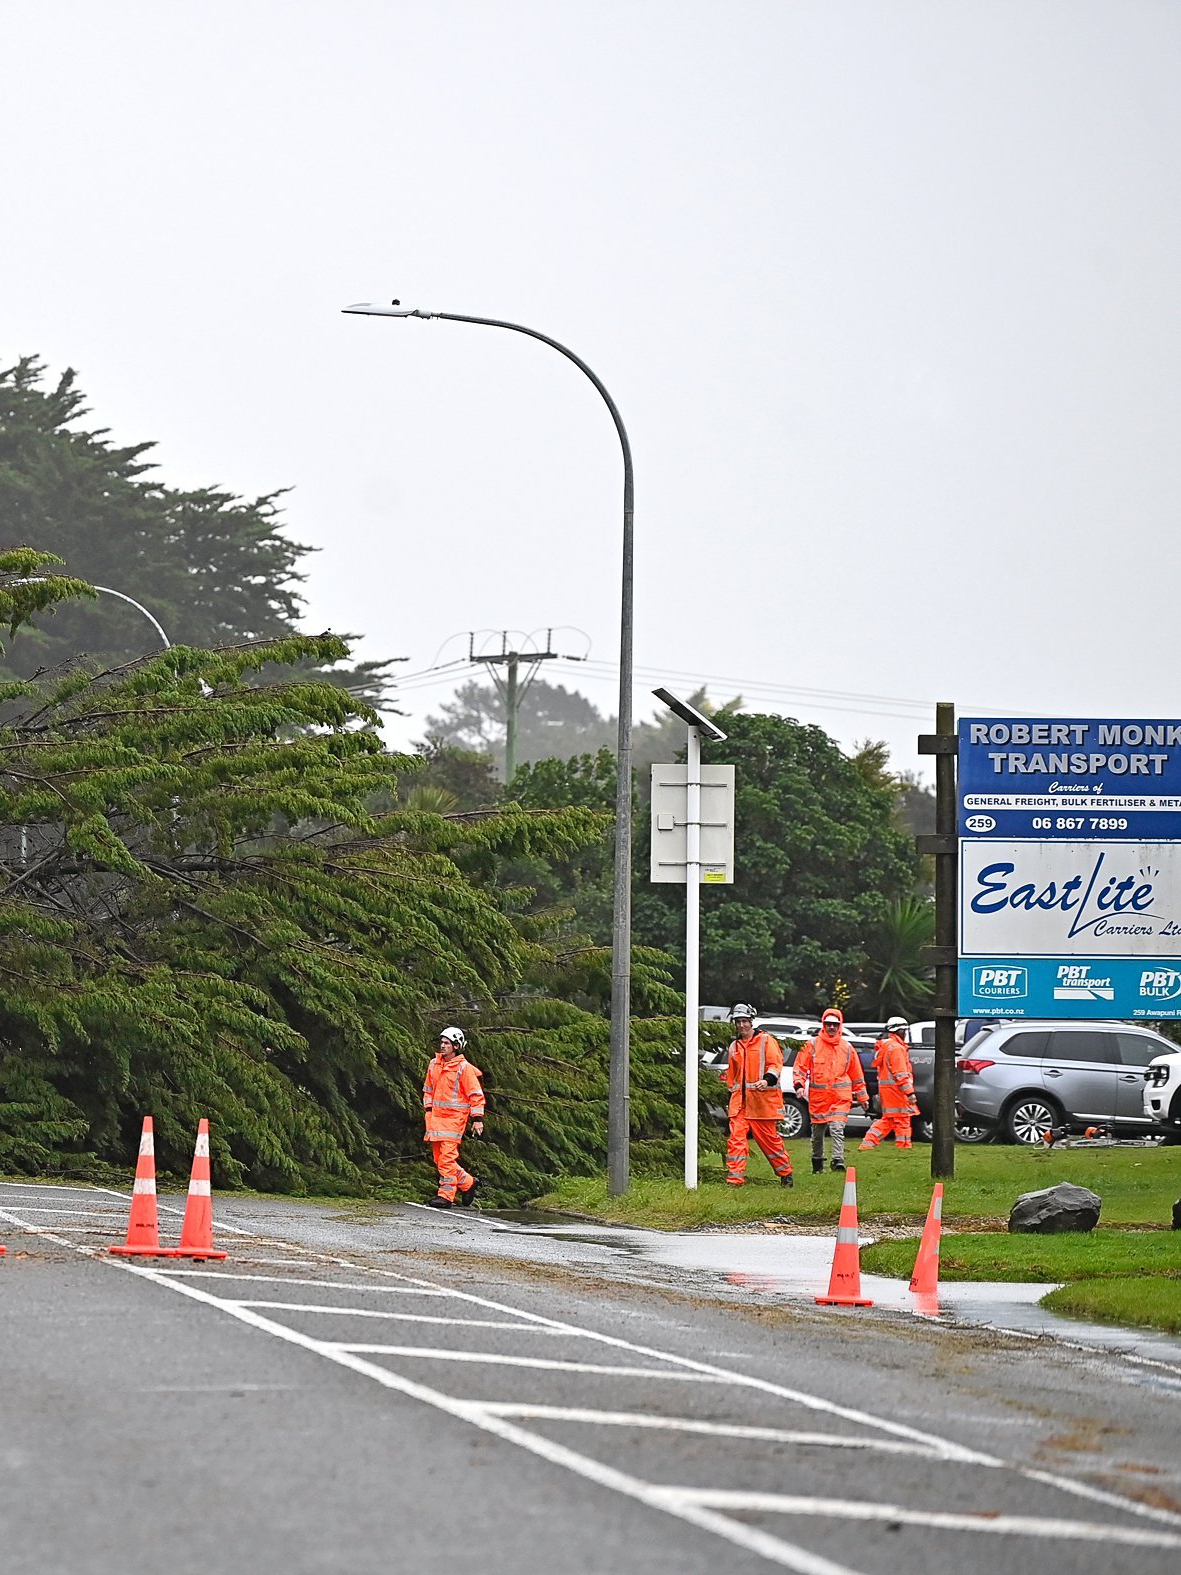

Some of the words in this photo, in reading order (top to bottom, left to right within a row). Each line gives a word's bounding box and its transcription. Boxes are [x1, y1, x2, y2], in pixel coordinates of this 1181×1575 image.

[970, 723, 1089, 746] ROBERT
[1098, 725, 1181, 746] MONK
[988, 752, 1168, 775] TRANSPORT
[1048, 781, 1090, 793] Carriers
[1092, 782, 1104, 794] of
[966, 797, 1013, 806] GENERAL
[1015, 798, 1059, 808] FREIGHT,
[1061, 798, 1087, 807] BULK
[1090, 799, 1147, 807] FERTILISER
[1149, 799, 1156, 807] &
[969, 818, 993, 828] 259
[1032, 817, 1052, 830] 06
[1056, 817, 1085, 830] 867
[1089, 818, 1128, 830] 7899
[1094, 920, 1154, 937] Carriers
[979, 969, 1022, 986] PBT
[1057, 965, 1091, 979] PBT
[1062, 977, 1111, 988] transport
[1139, 971, 1180, 987] PBT
[979, 987, 1020, 995] COURIERS
[1139, 987, 1170, 996] BULK
[973, 1007, 1024, 1015] www.pbt.co.nz
[1146, 1009, 1175, 1017] Awapuni
